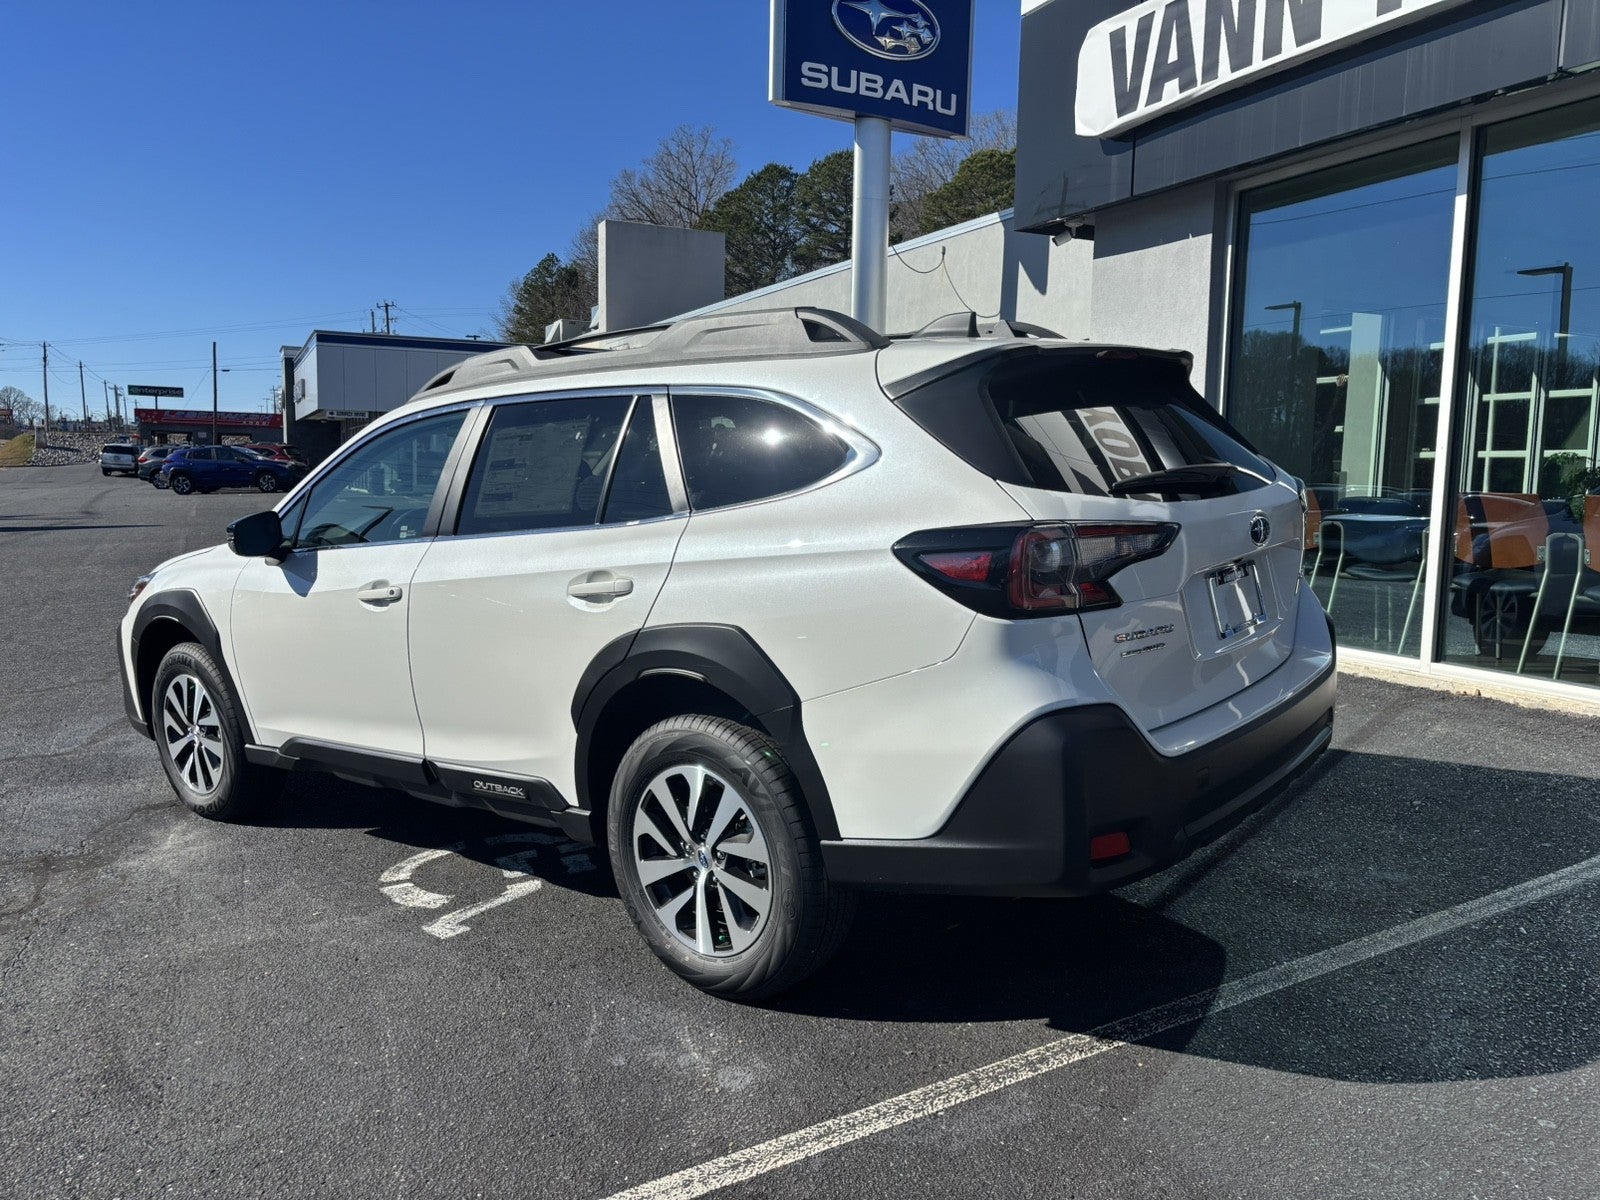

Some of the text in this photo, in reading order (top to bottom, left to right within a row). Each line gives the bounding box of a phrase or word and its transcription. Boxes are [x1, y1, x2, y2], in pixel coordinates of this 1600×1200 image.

[1110, 0, 1322, 118] VANN
[801, 61, 957, 116] SUBARU
[130, 386, 182, 396] enterprise
[473, 780, 525, 796] OUTBACK
